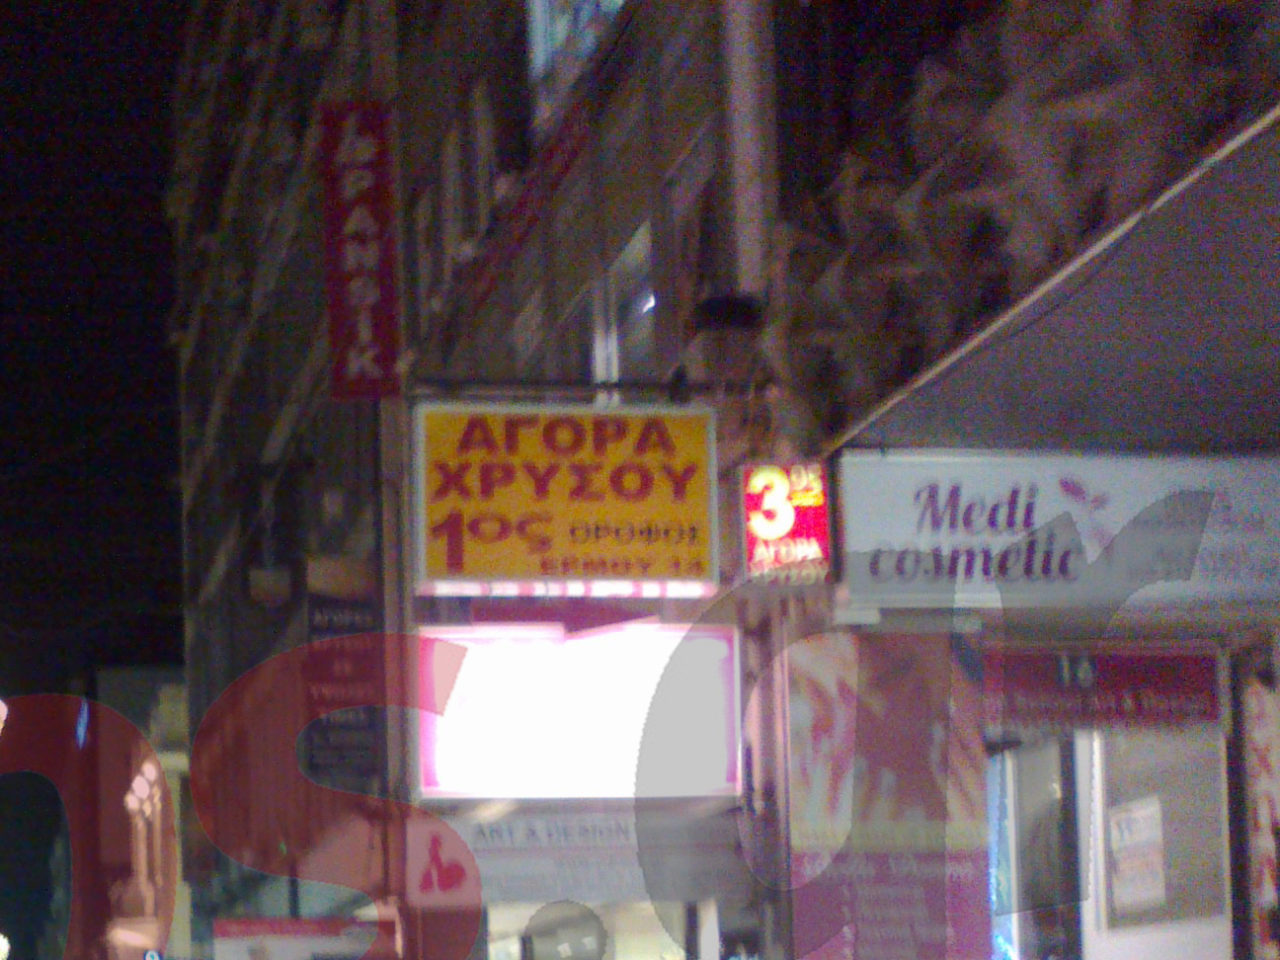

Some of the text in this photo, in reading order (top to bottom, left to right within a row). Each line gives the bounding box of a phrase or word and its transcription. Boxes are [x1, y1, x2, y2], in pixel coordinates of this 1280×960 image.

[456, 415, 675, 457] ΑΓΟΡΑ
[431, 462, 699, 502] ΧΡΥΣΟΥ
[913, 477, 1039, 535] Medi
[868, 535, 1086, 585] cosmetic
